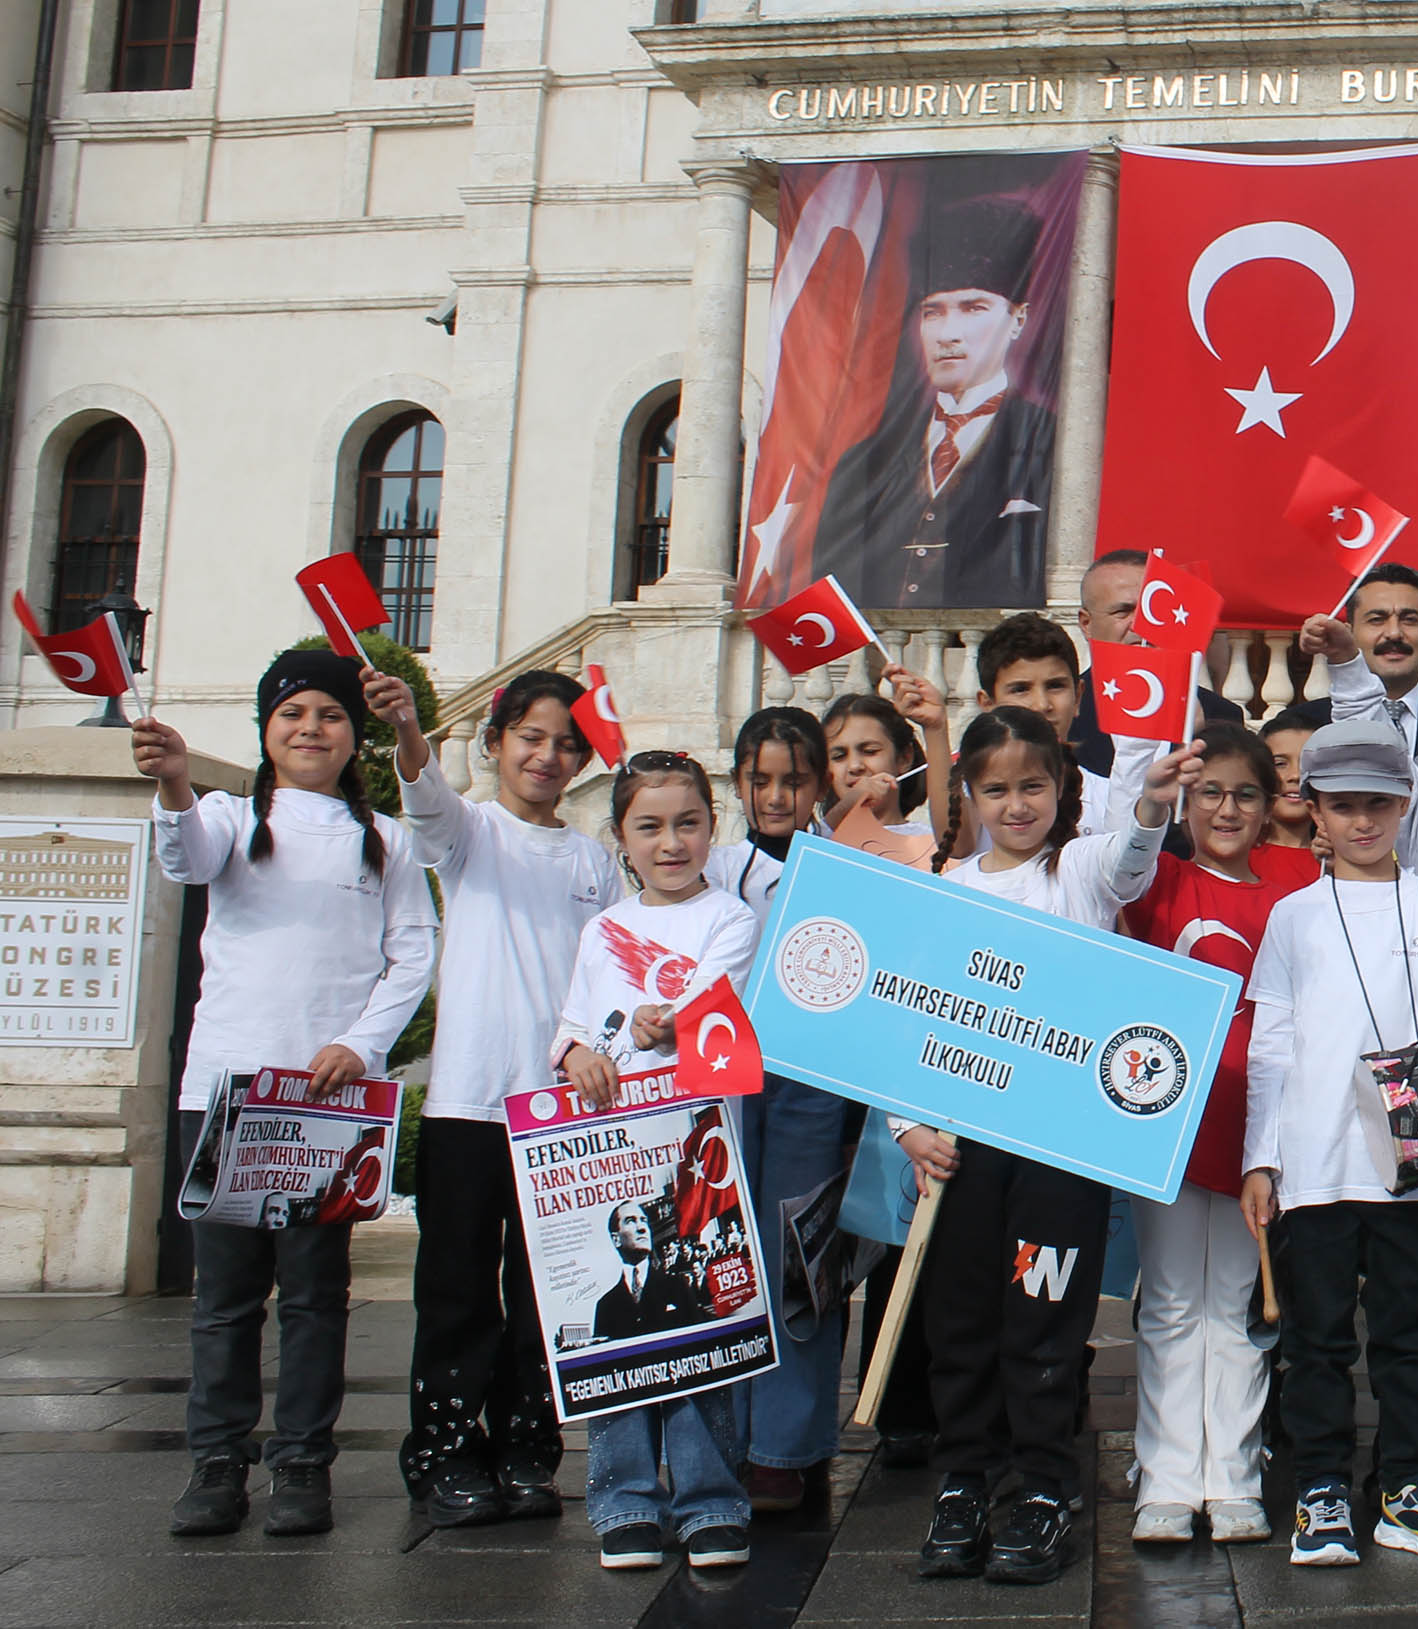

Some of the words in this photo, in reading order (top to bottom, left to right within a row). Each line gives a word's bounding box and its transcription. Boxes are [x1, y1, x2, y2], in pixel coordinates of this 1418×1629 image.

[768, 76, 1064, 121] CUMHURİYETİN
[1097, 68, 1299, 110] TEMELİNİ
[0, 909, 125, 935] TATÜRK
[2, 945, 121, 967] ONGRE
[968, 948, 1025, 991] SİVAS
[5, 972, 119, 998] ÜZESİ
[1, 1011, 54, 1031] YLÜL
[67, 1014, 115, 1032] 1919
[871, 970, 987, 1031] HAYIRSEVER
[988, 1006, 1044, 1049] LÜTFİ
[1041, 1027, 1094, 1065] ABAY
[921, 1033, 1014, 1091] İLKOKULU
[276, 1076, 368, 1110] TOMCUK
[525, 1127, 636, 1169] EFENDİLER,
[529, 1162, 577, 1193] YARIN
[535, 1192, 573, 1218] İLAN
[577, 1173, 655, 1209] EDECEĞİZ!
[716, 1266, 749, 1292] 1923
[626, 1364, 669, 1392] KAYITSIZ
[669, 1358, 710, 1386] ŞARTSIZ
